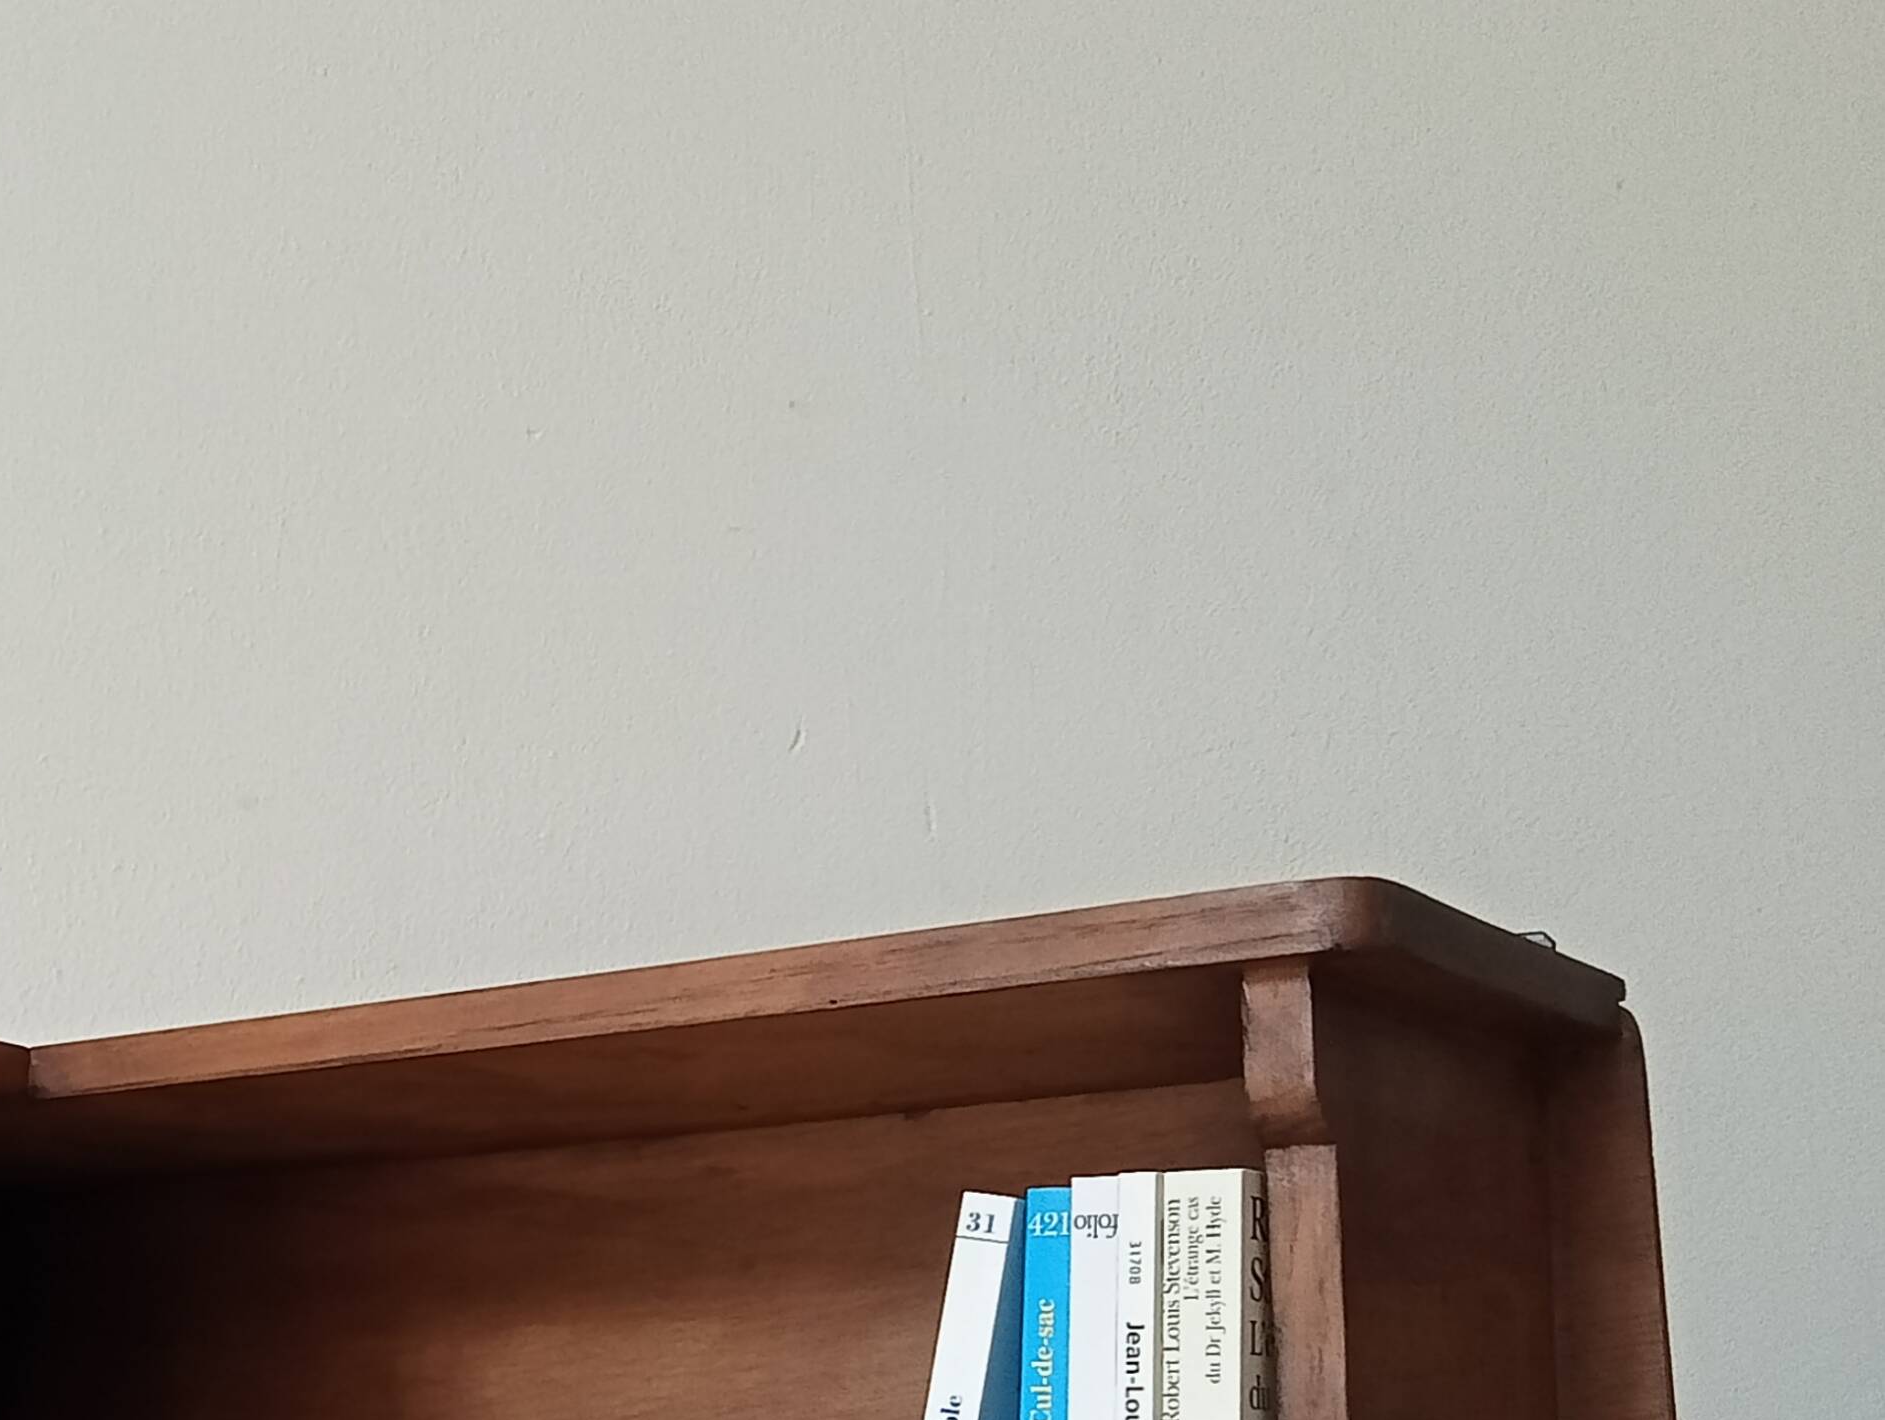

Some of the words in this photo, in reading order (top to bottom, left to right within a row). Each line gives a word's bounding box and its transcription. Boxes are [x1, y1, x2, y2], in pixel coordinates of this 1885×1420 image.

[1187, 1197, 1199, 1221] cas
[1205, 1197, 1226, 1238] Hyde
[966, 1212, 995, 1233] 31
[1027, 1212, 1071, 1237] 421
[1074, 1213, 1119, 1238] folio
[1161, 1199, 1181, 1294] Stevenson
[1205, 1245, 1221, 1264] M.
[1129, 1241, 1142, 1285] 31708
[1183, 1227, 1203, 1300] L'étrange
[1207, 1270, 1221, 1285] et
[1204, 1290, 1226, 1334] Jekyll
[1162, 1300, 1180, 1351] Louis
[1205, 1337, 1221, 1357] Dr
[1204, 1363, 1221, 1384] du
